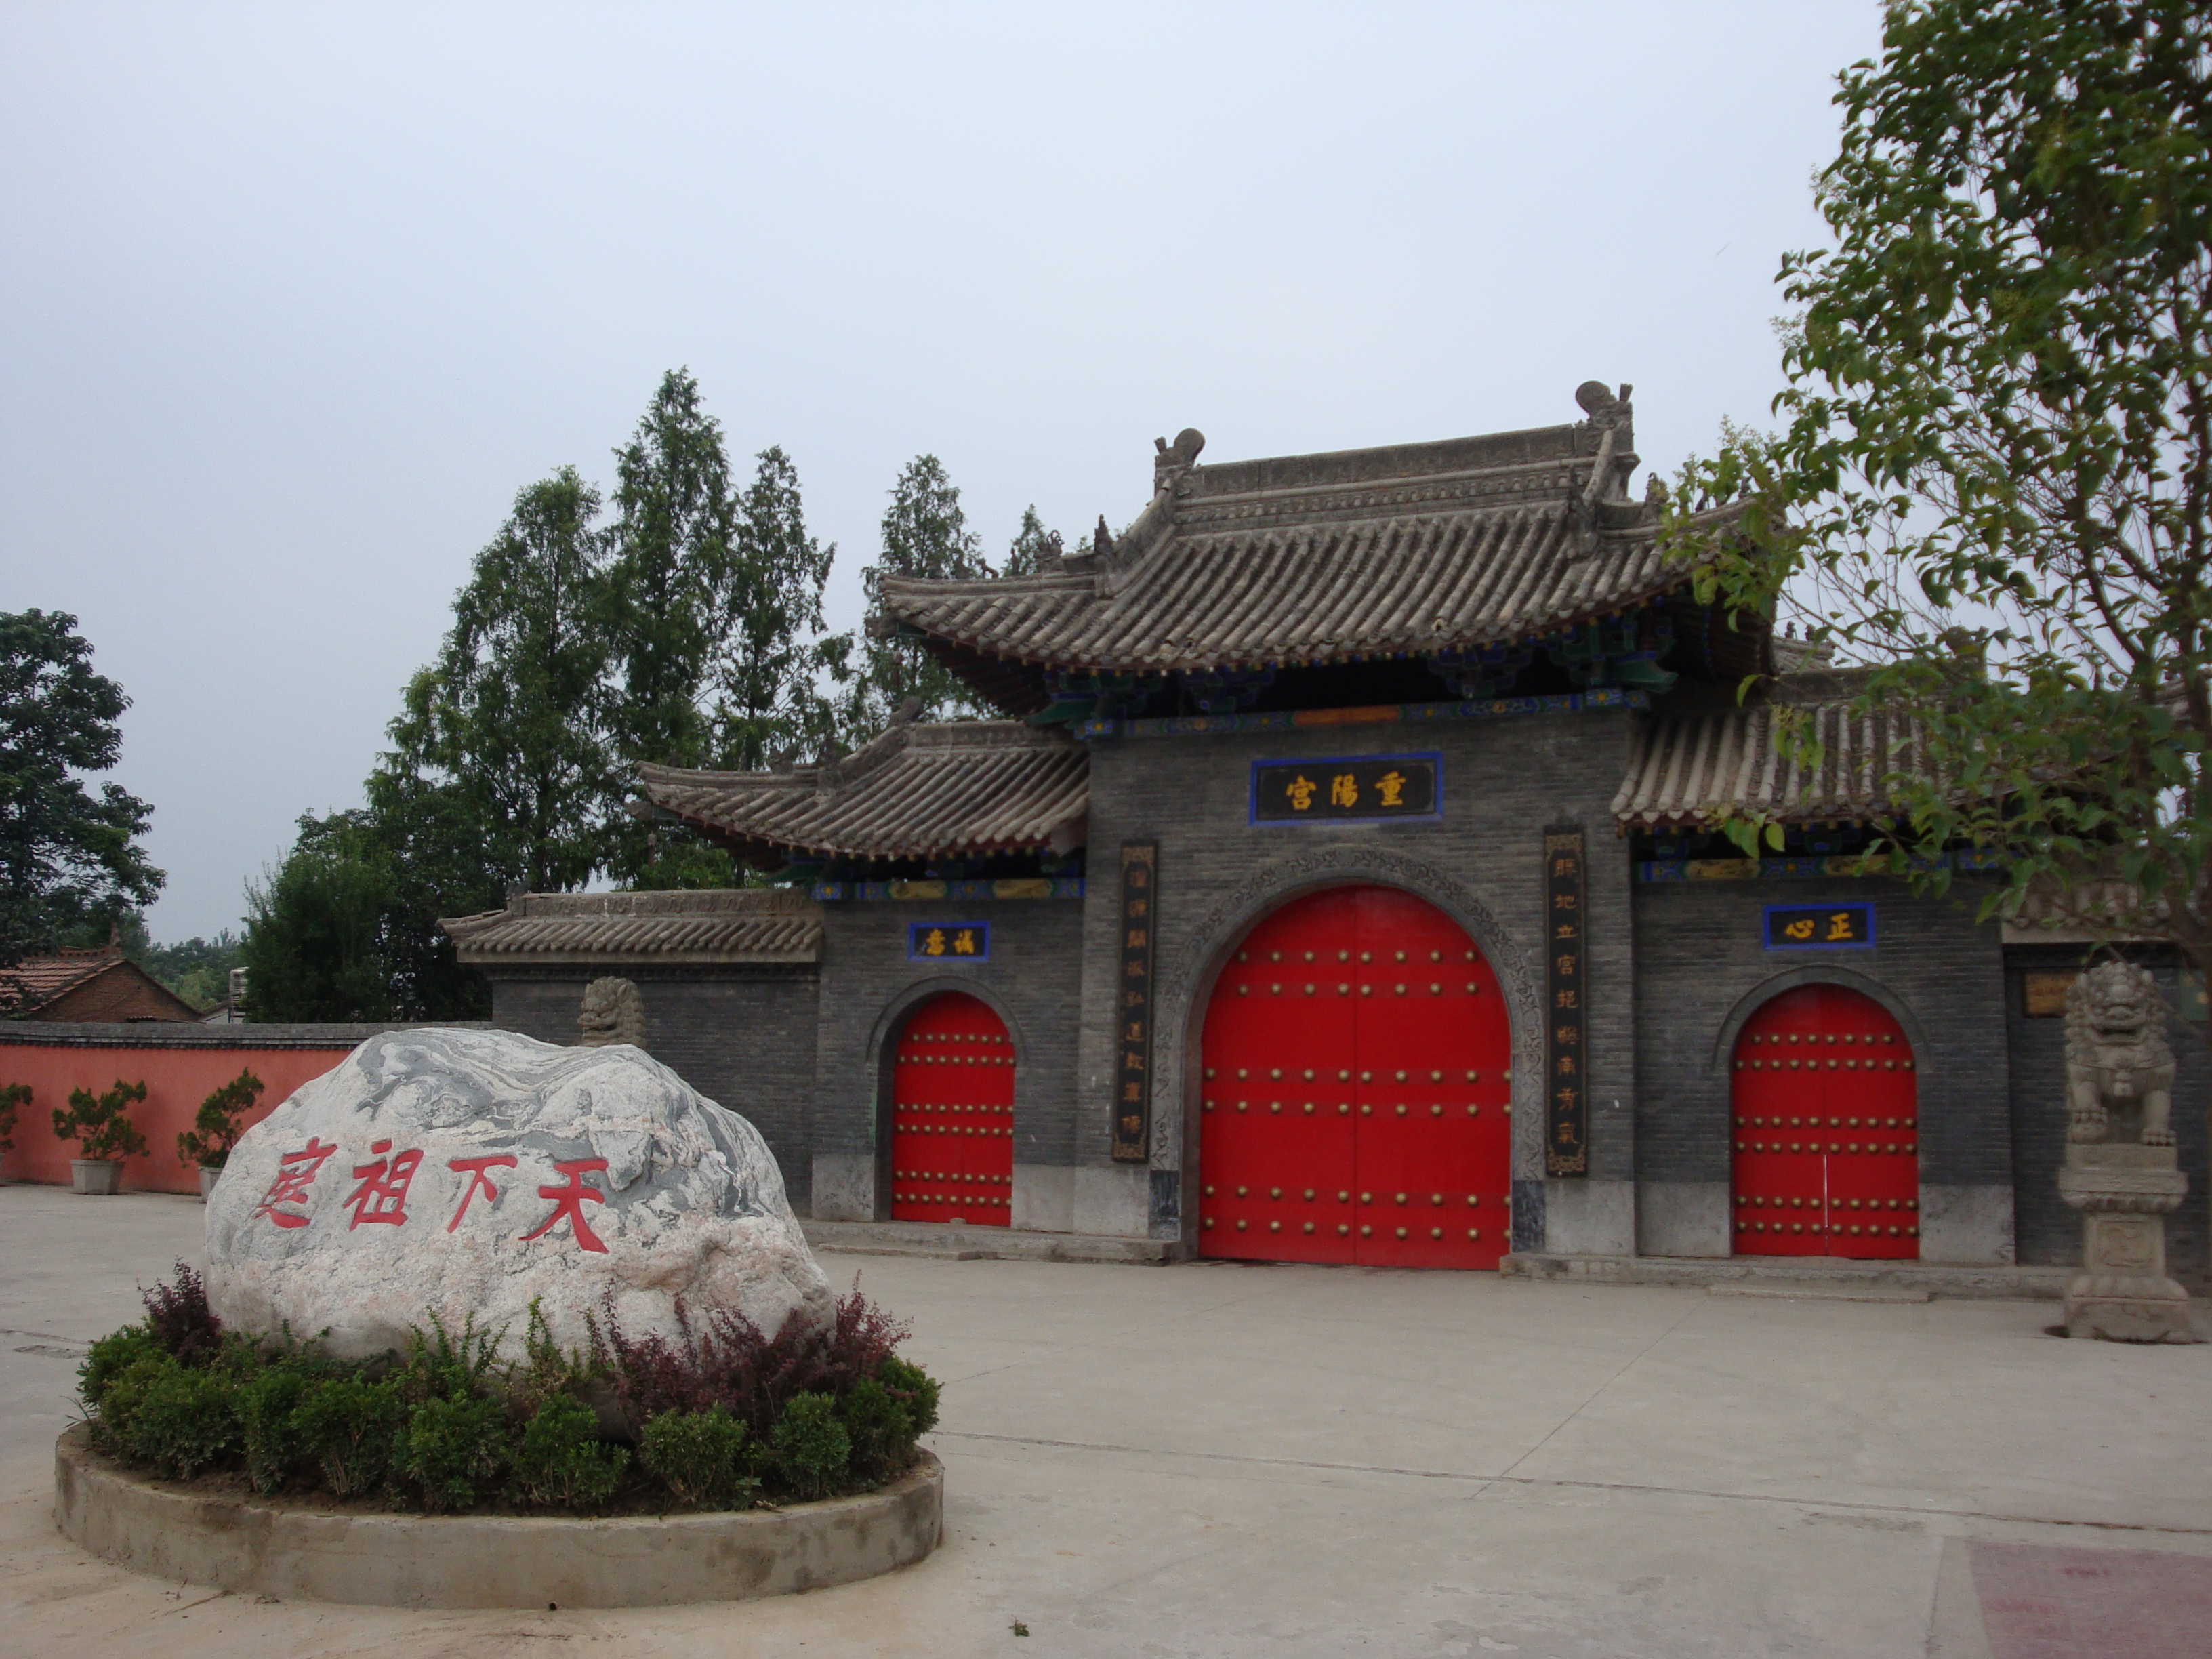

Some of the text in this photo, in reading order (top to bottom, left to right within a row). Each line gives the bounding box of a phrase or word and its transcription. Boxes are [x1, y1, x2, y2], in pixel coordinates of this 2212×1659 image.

[1286, 771, 1406, 811] 重陽宮
[1784, 912, 1854, 941] 正心
[255, 1136, 610, 1254] 天下祖庭
